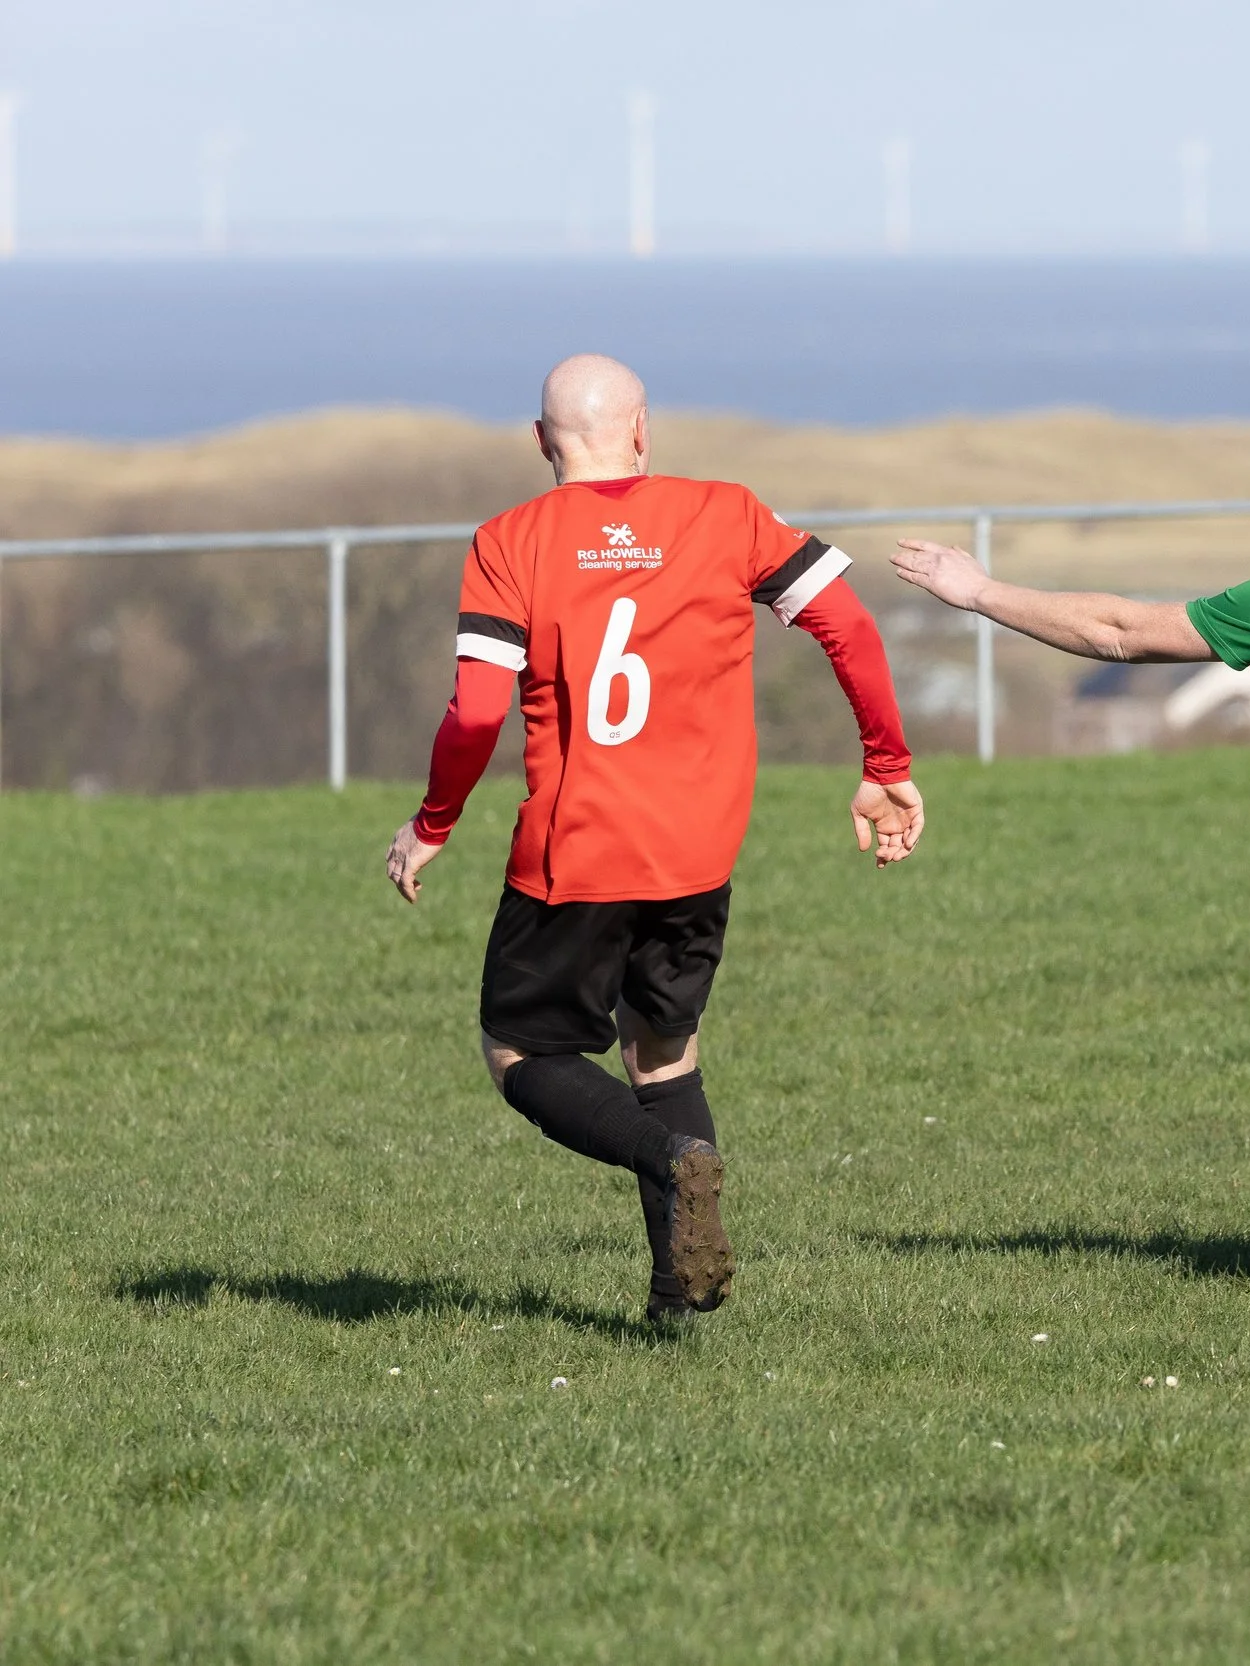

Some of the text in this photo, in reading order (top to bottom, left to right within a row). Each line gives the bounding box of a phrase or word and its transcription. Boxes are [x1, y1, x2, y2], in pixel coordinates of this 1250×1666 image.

[577, 547, 662, 560] RG HOWELLS
[578, 559, 663, 571] cleaning services
[587, 597, 650, 746] 6
